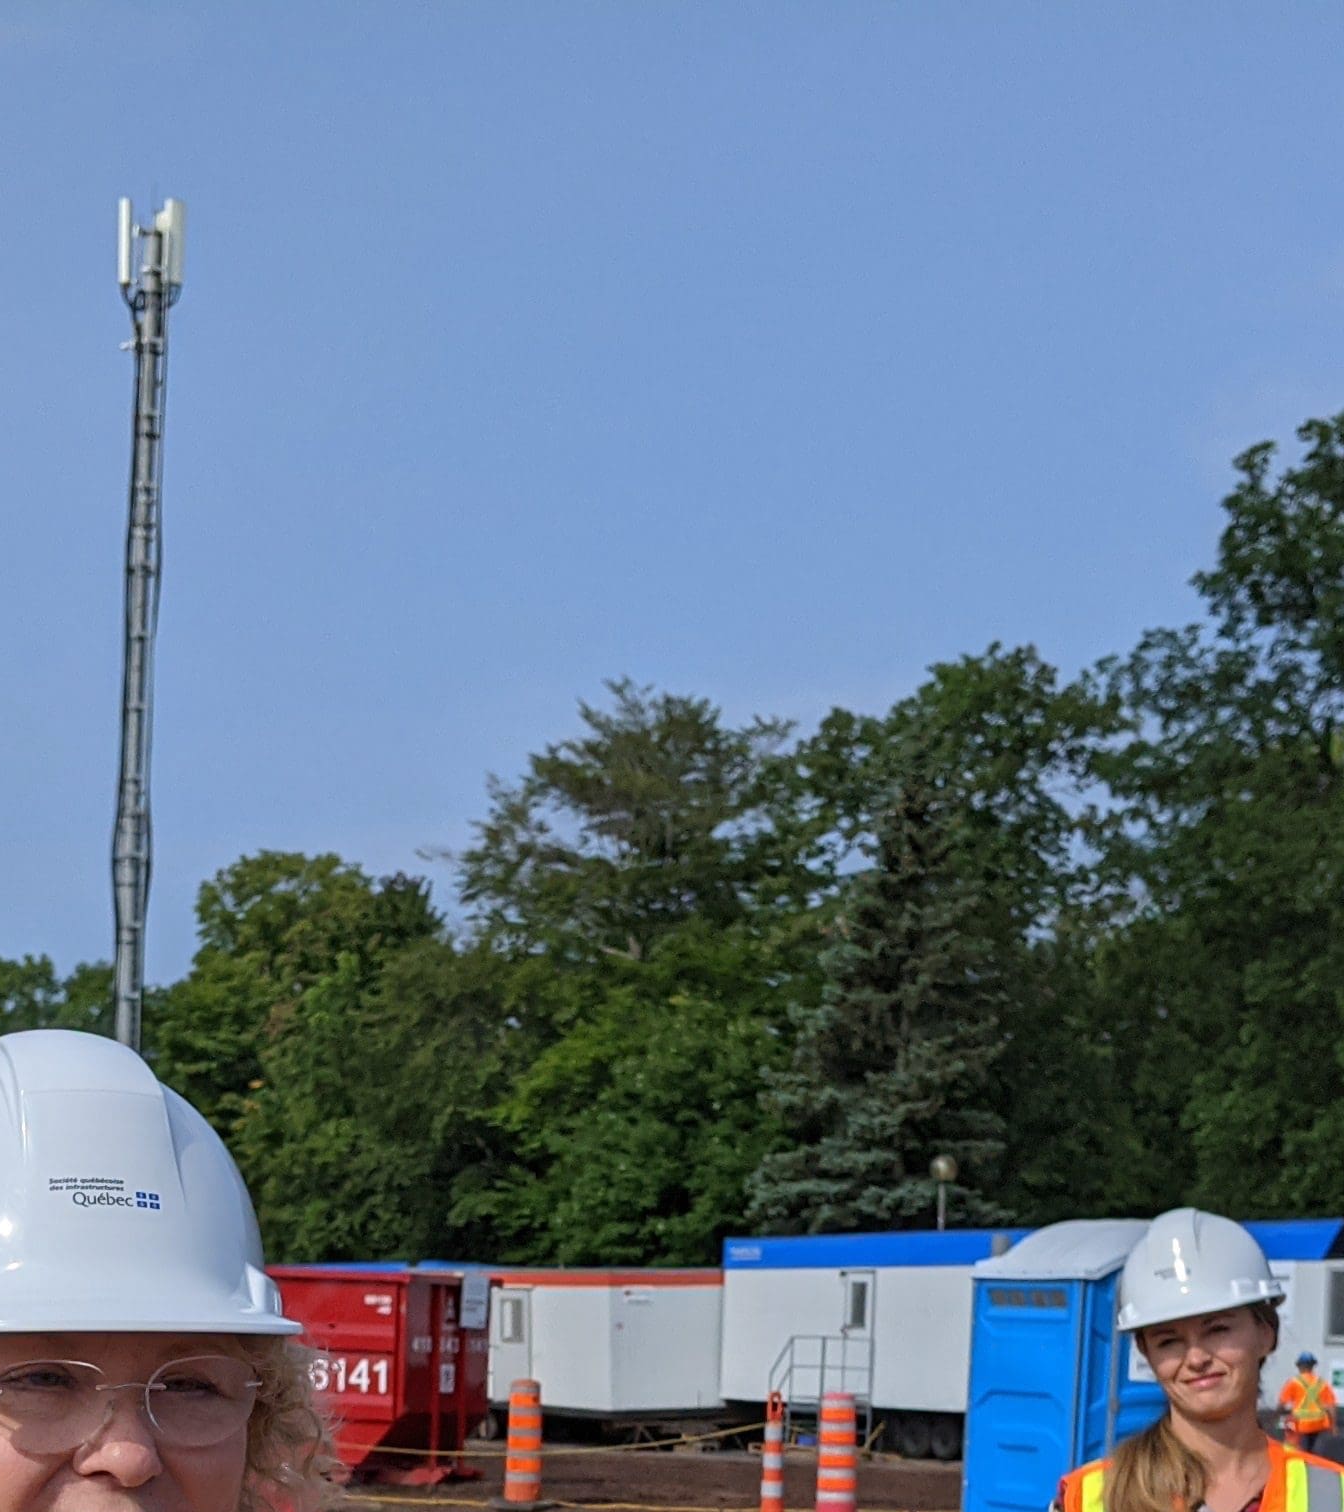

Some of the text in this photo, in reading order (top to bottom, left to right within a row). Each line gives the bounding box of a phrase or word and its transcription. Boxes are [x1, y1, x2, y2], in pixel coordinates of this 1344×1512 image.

[49, 1177, 78, 1185] Société
[49, 1184, 124, 1192] des infrastructures
[72, 1191, 134, 1208] Québec
